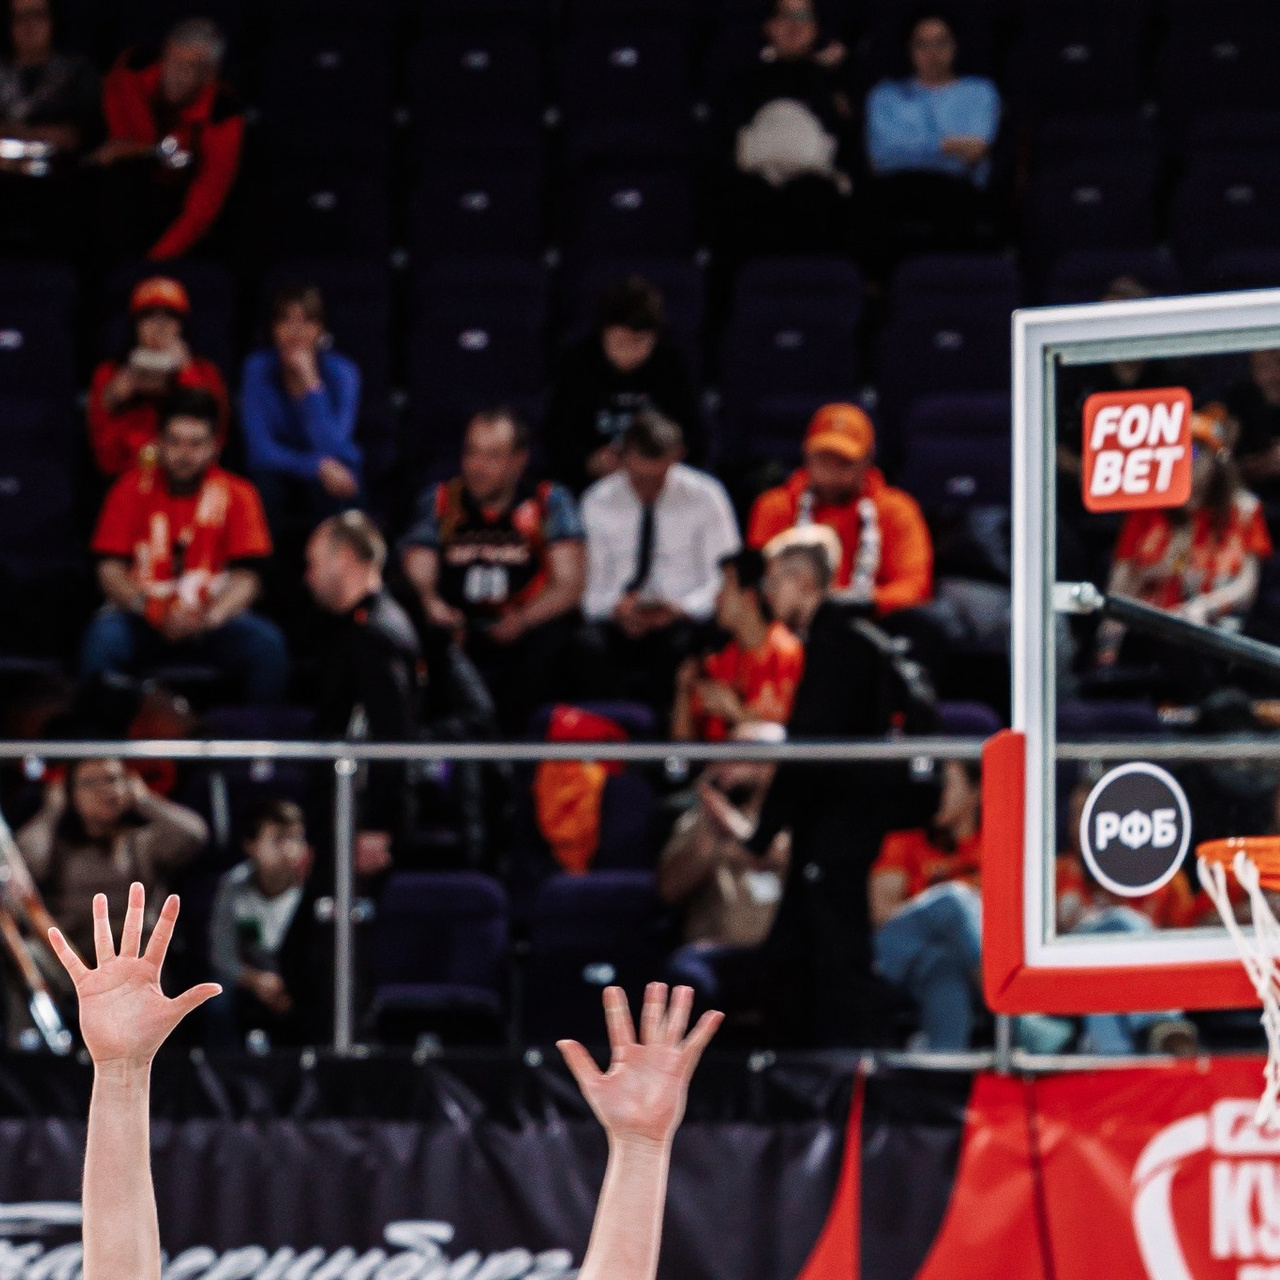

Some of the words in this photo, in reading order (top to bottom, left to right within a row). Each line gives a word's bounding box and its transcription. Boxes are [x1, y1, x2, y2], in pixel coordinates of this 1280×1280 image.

[1090, 401, 1185, 451] FON
[1090, 445, 1185, 497] BET
[1095, 808, 1178, 851] РФБ
